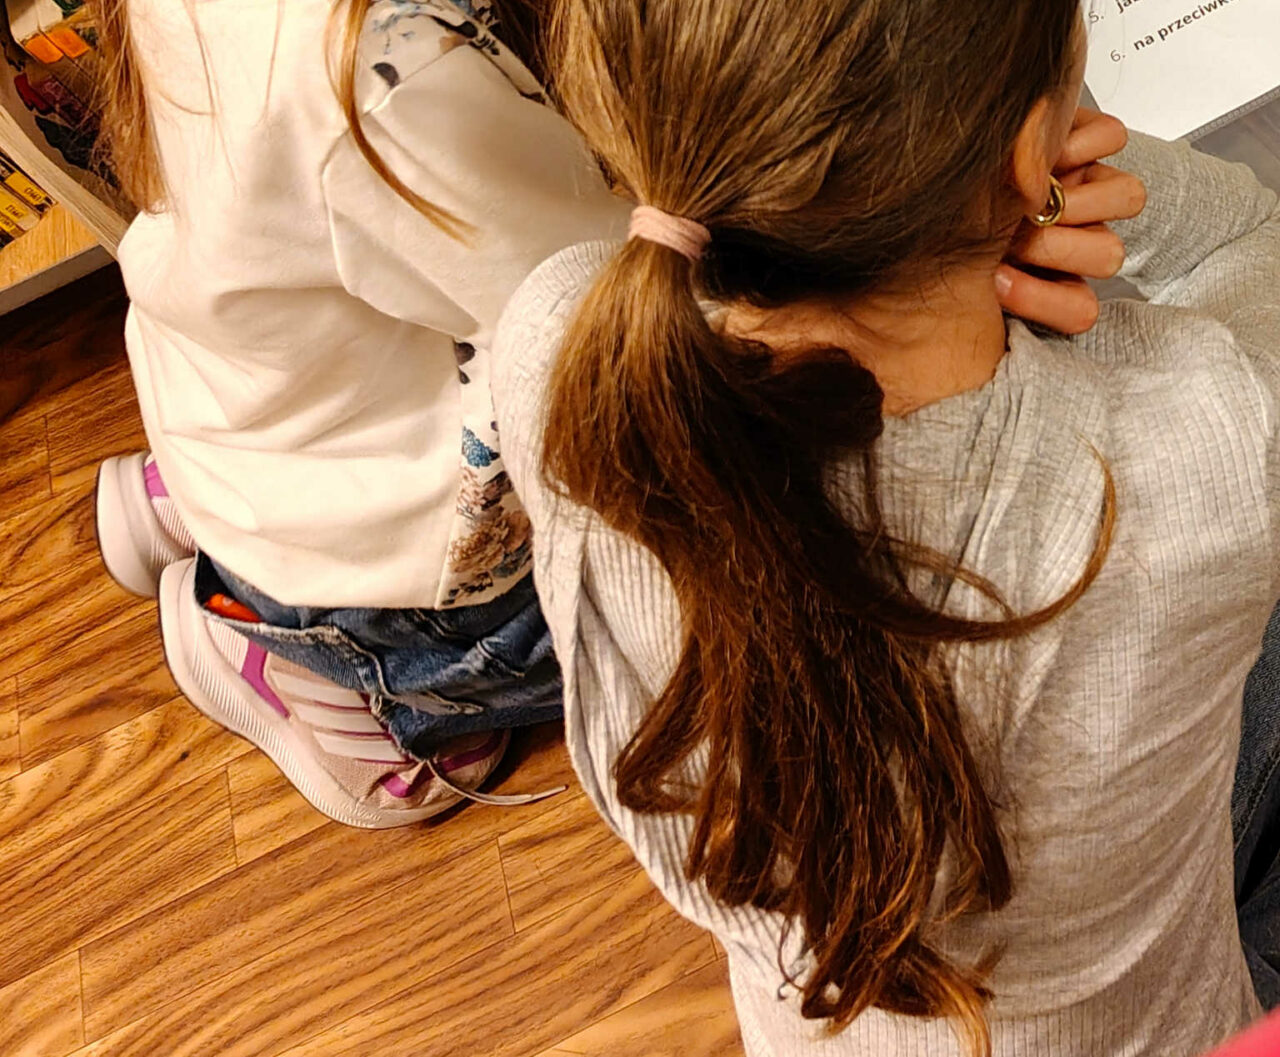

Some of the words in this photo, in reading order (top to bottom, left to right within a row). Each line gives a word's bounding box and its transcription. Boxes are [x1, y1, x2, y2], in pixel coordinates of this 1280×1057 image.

[1088, 10, 1105, 24] 5.
[1110, 49, 1126, 63] 6.
[1133, 34, 1155, 51] na
